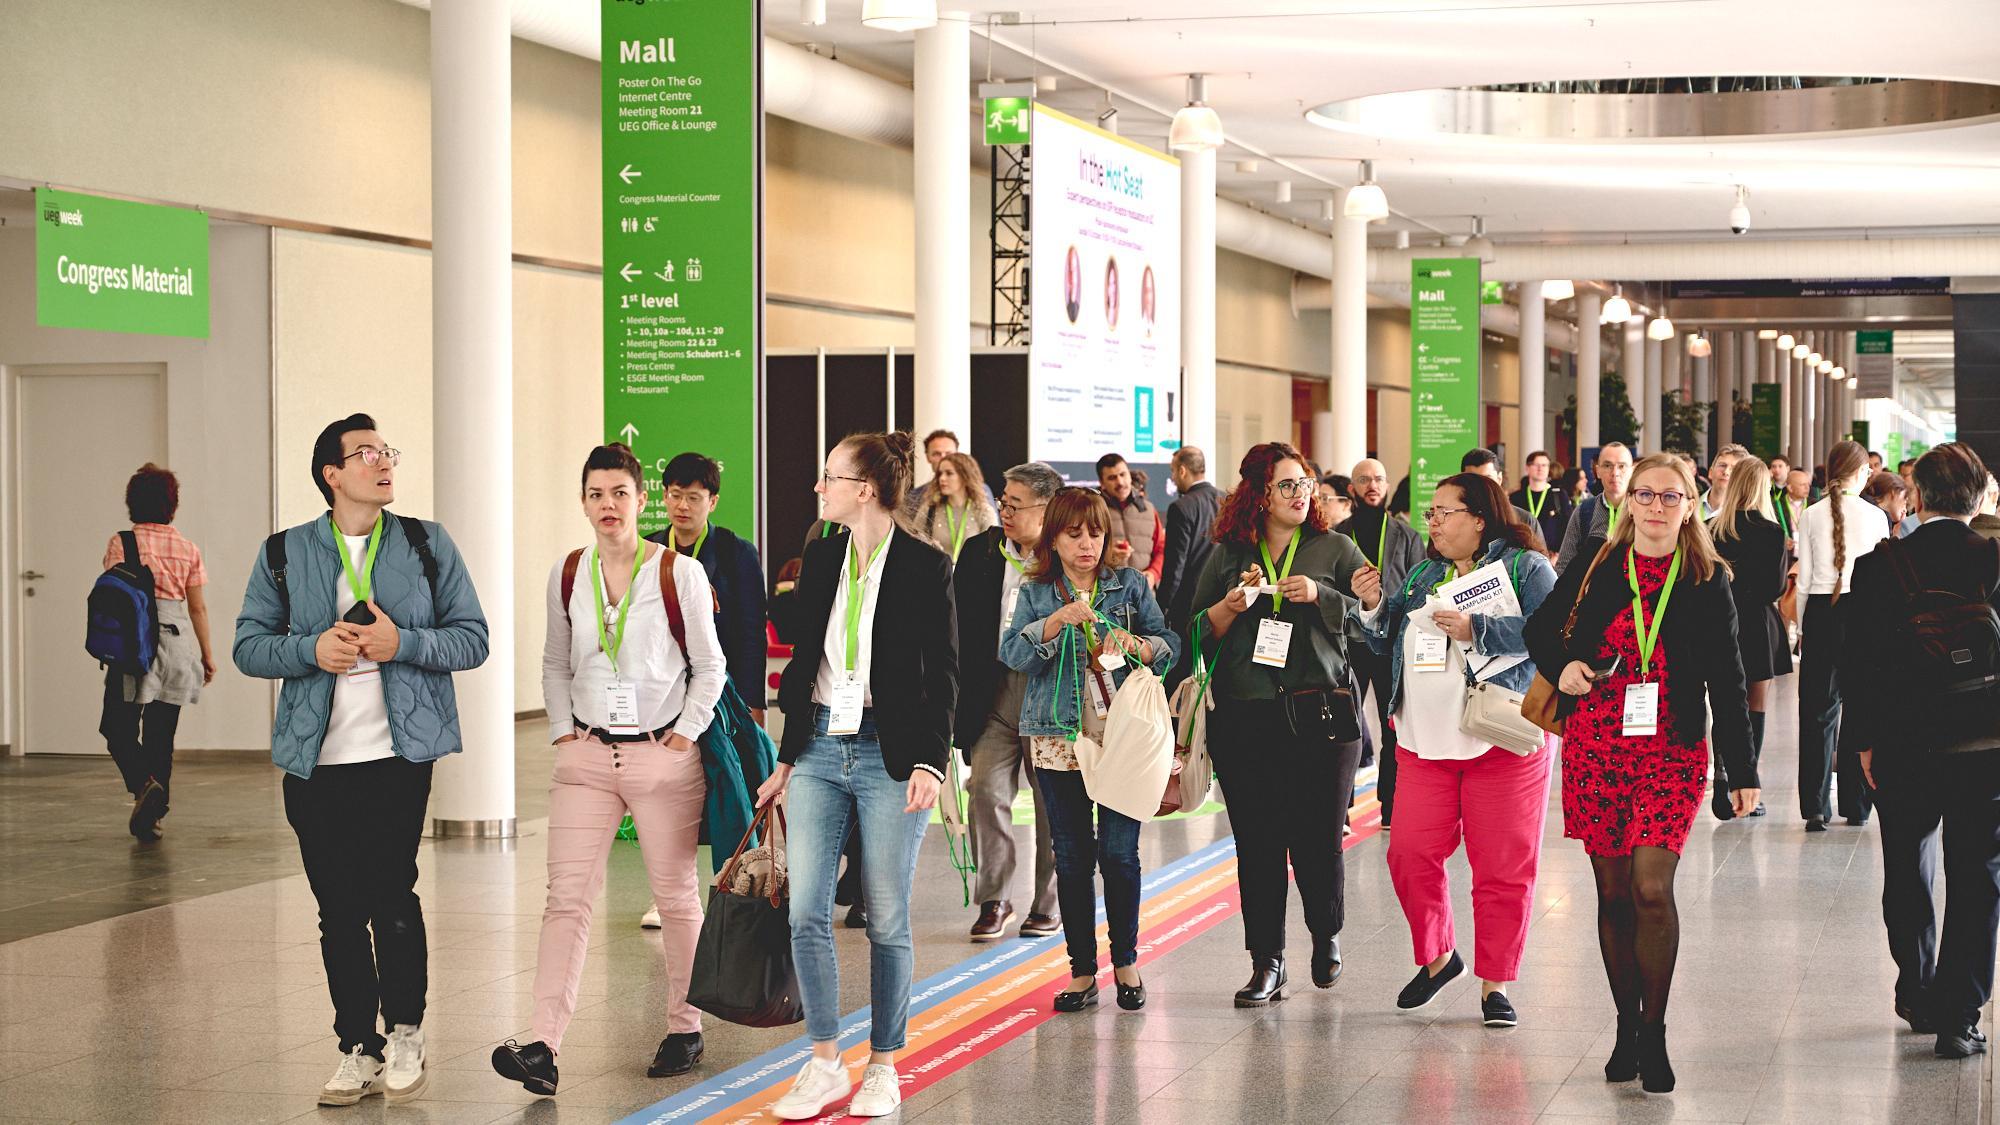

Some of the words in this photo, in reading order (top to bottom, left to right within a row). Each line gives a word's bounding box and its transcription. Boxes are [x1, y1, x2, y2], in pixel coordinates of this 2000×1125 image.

[619, 37, 676, 64] Mall
[618, 77, 649, 88] Poster
[651, 76, 665, 87] On
[667, 76, 686, 86] The
[687, 75, 702, 86] Go
[618, 92, 657, 103] Internet
[659, 91, 692, 101] Centre
[618, 106, 657, 118] Meeting
[659, 105, 688, 116] Room
[690, 105, 703, 115] 21
[618, 121, 640, 132] UEG
[641, 120, 669, 131] Office
[671, 121, 679, 130] &
[681, 119, 717, 132] Lounge
[1079, 148, 1088, 182] In
[1089, 153, 1104, 188] the
[1106, 159, 1121, 193] Hot
[1124, 165, 1143, 200] Seat
[618, 194, 655, 205] Congress
[656, 193, 688, 203] Material
[689, 193, 721, 202] Counter
[57, 255, 128, 294] Congress
[131, 263, 193, 296] Material
[1419, 290, 1445, 302] Mall
[1800, 288, 1816, 296] Join
[620, 294, 638, 308] 1st
[641, 293, 679, 308] level
[626, 316, 657, 326] Meeting
[658, 315, 686, 324] Rooms
[626, 328, 632, 336] 1
[639, 327, 652, 337] 10,
[654, 328, 668, 336] 10a
[676, 327, 695, 337] 10d,
[696, 327, 706, 335] 11
[713, 327, 724, 335] 20
[626, 339, 657, 349] Meeting
[658, 338, 686, 347] Rooms
[687, 339, 698, 347] 22
[699, 339, 706, 347] &
[707, 338, 717, 346] 23
[626, 351, 657, 361] Meeting
[658, 350, 685, 359] Rooms
[686, 350, 723, 358] Schubert
[724, 350, 729, 358] 1
[735, 350, 741, 358] 6
[626, 362, 648, 371] Press
[649, 362, 675, 371] Centre
[626, 374, 647, 383] ESGE
[649, 373, 680, 384] Meeting
[681, 373, 704, 382] Room
[626, 386, 669, 394] Restaurant
[1454, 578, 1500, 602] VALIDOSS
[1457, 594, 1492, 612] SAMPLING
[1493, 588, 1504, 597] KIT
